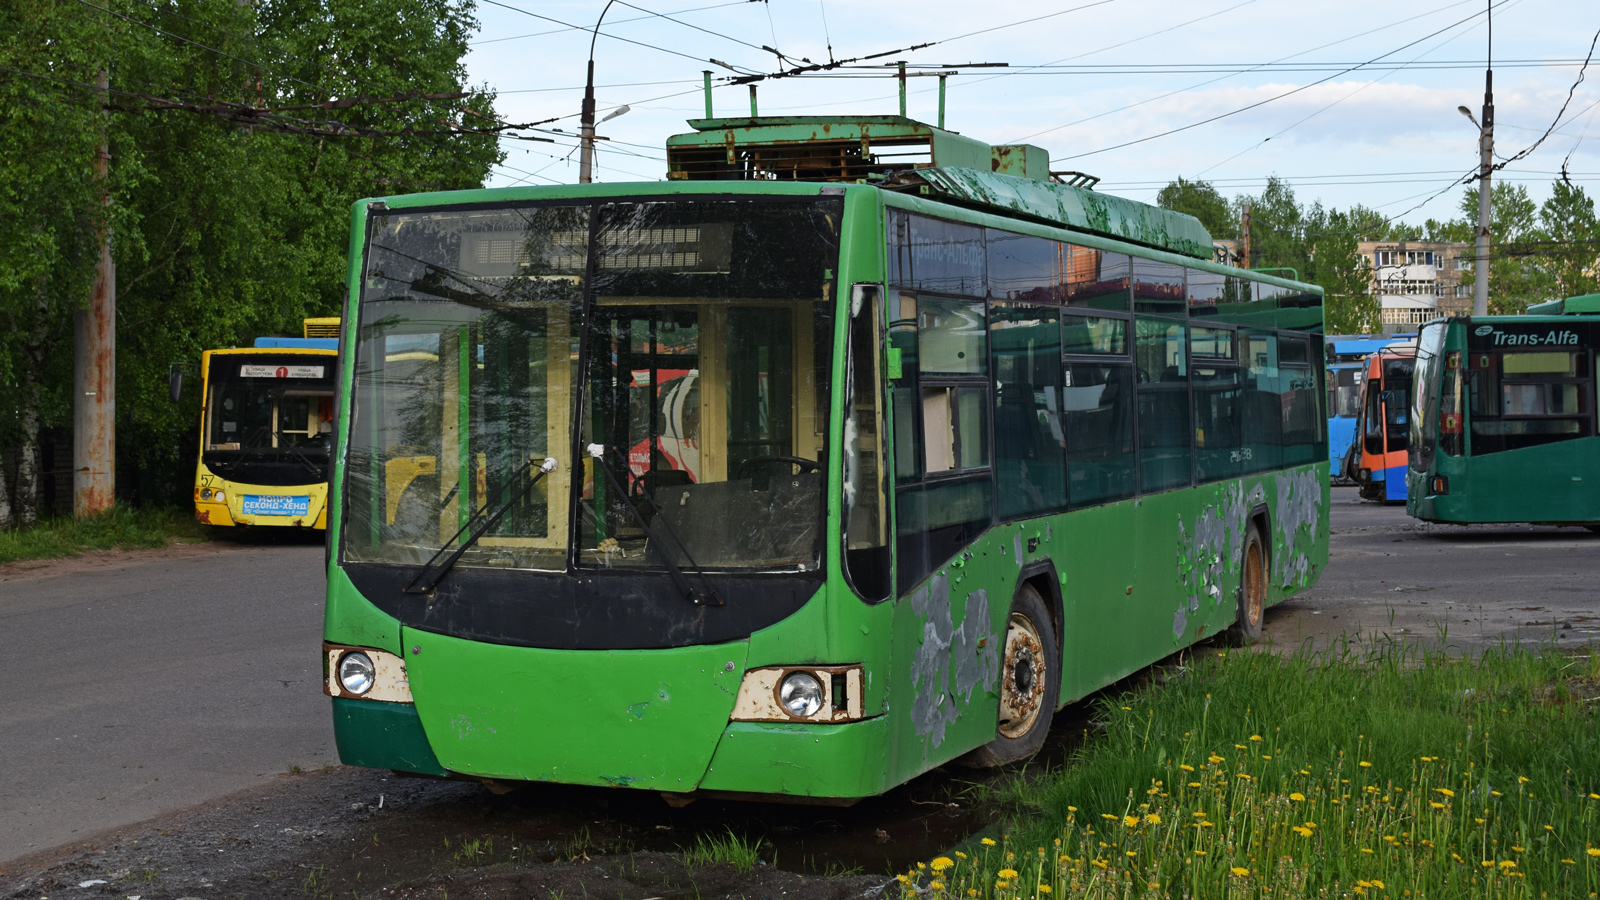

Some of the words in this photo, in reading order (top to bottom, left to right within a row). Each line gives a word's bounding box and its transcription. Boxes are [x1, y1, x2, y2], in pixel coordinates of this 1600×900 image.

[910, 228, 984, 273] Транс-Альфа
[1493, 330, 1578, 345] Trans-Alfa
[201, 474, 215, 487] 57
[244, 501, 307, 510] СЕКОНД-ХЕНД
[258, 495, 293, 503] МОНРО
